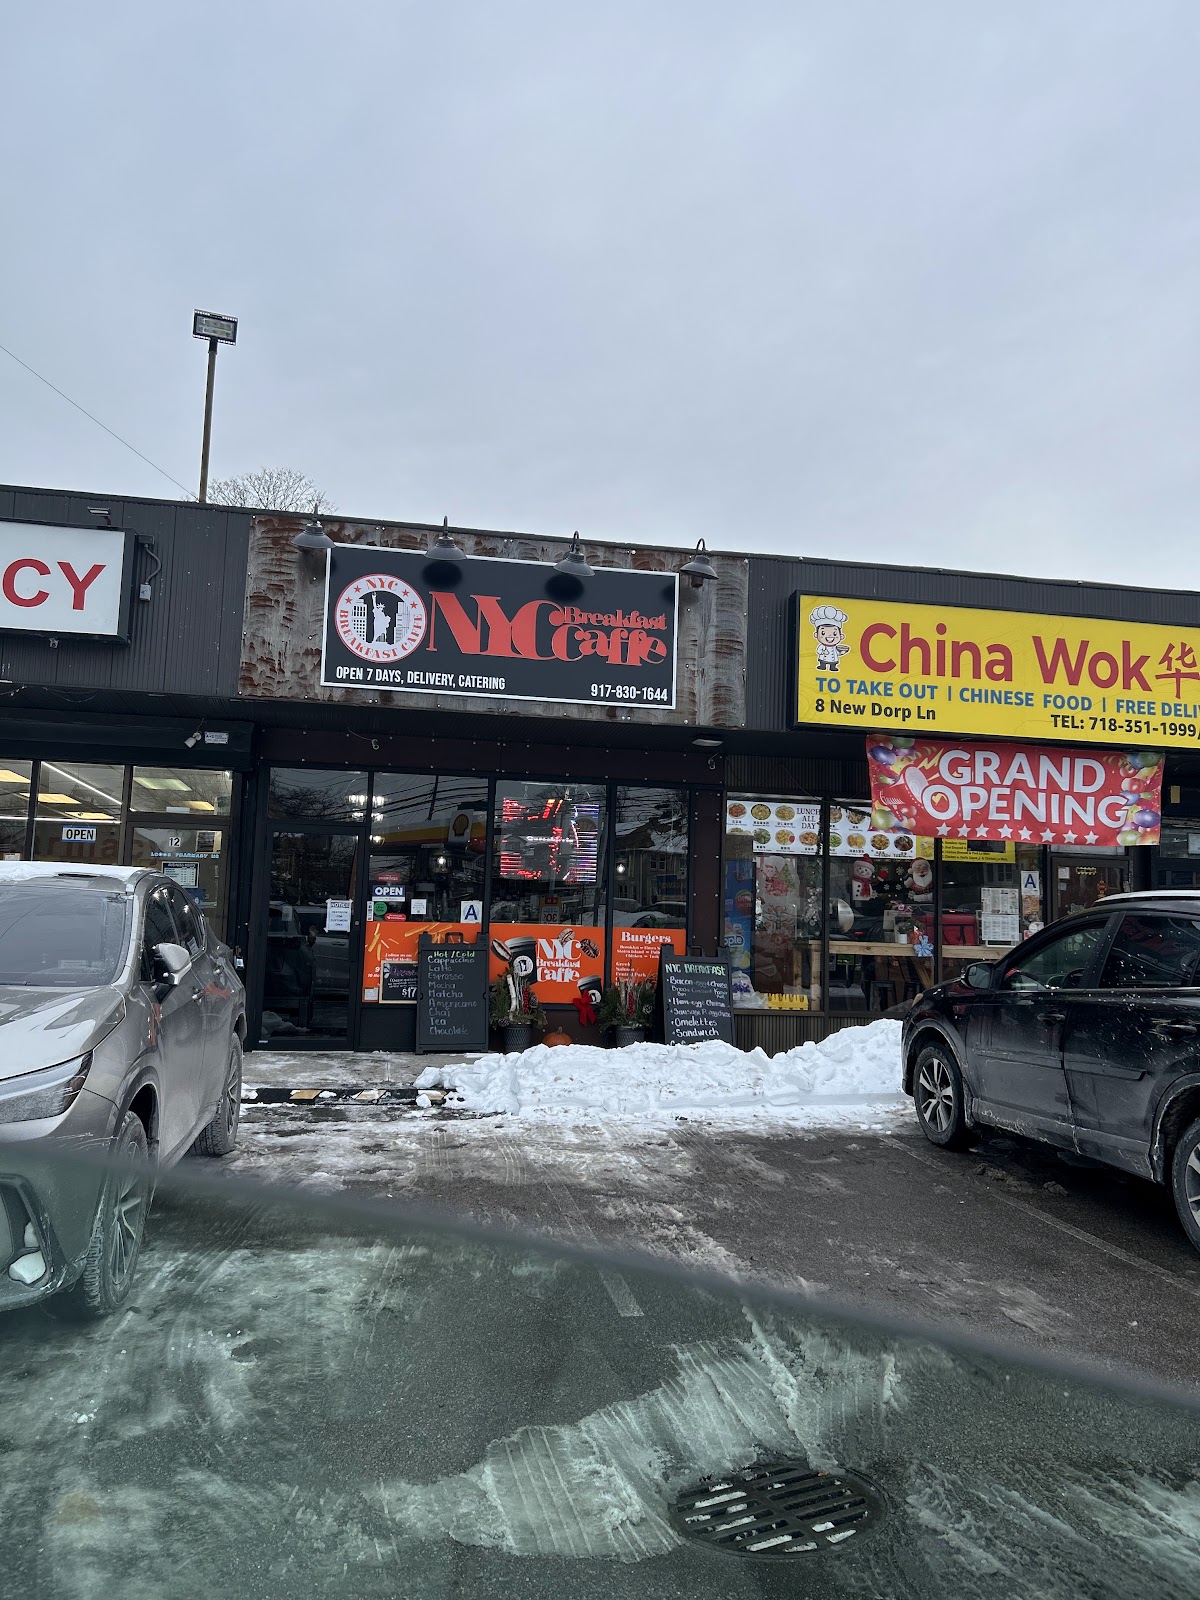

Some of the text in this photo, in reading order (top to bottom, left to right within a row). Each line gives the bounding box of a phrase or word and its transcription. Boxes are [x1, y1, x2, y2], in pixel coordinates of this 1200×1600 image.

[2, 558, 106, 611] CY
[366, 578, 398, 590] NYC
[426, 591, 566, 660] NYC
[564, 606, 667, 630] Breakfast
[340, 610, 398, 659] BREAKFAST
[401, 614, 422, 651] CAFFE
[552, 624, 667, 666] Caffe
[860, 622, 1152, 692] China Wok
[336, 666, 506, 690] OPEN 7 DAYS, DELIVERY, CATERING
[591, 684, 668, 702] 917-830-1644
[815, 677, 841, 694] TO
[846, 679, 894, 698] TAKE
[900, 682, 938, 700] OUT
[959, 686, 1034, 707] CHINESE
[1043, 693, 1092, 711] FOOD
[1116, 698, 1156, 716] FREE
[1162, 702, 1200, 718] DELI
[815, 698, 936, 722] 8 New Dorp Ln
[1050, 714, 1200, 740] TEL: 718-351-1999
[939, 749, 1106, 794] GRAND
[922, 785, 1129, 828] OPENING
[66, 828, 94, 840] OPEN
[170, 838, 180, 847] 12
[1024, 874, 1036, 888] A
[375, 886, 403, 896] OPEN
[464, 904, 478, 920] A
[622, 932, 671, 944] Burgers
[538, 939, 581, 960] NYC
[537, 959, 580, 967] Breakfast
[665, 963, 681, 973] NYC
[428, 972, 464, 980] Espresso
[537, 968, 580, 982] Caffe
[430, 1025, 469, 1035] Chocolate
[675, 1016, 717, 1026] Omelettes
[676, 1028, 719, 1037] Sandwich
